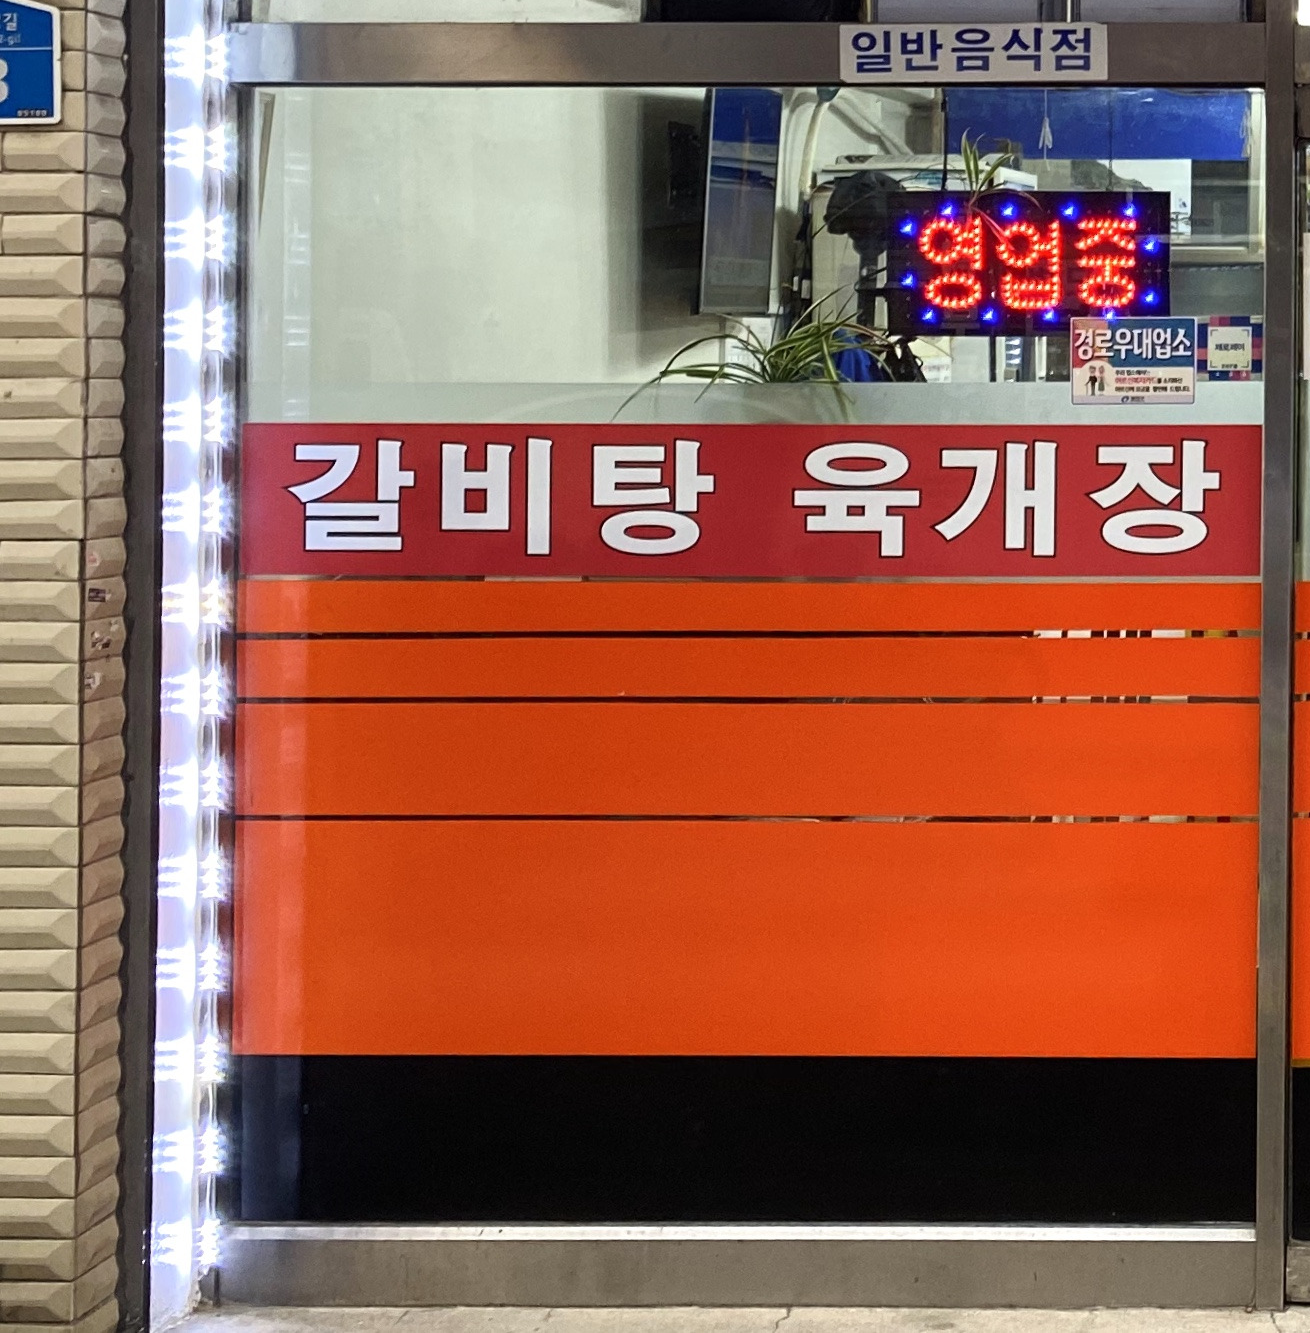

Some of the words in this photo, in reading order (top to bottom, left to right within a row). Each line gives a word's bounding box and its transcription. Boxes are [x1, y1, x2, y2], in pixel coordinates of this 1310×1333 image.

[850, 27, 1093, 74] 일반음식점
[917, 216, 1138, 311] 영업중
[1074, 327, 1192, 361] 경로우대업소
[285, 436, 717, 558] 갈비탕
[792, 436, 1222, 559] 육개장
